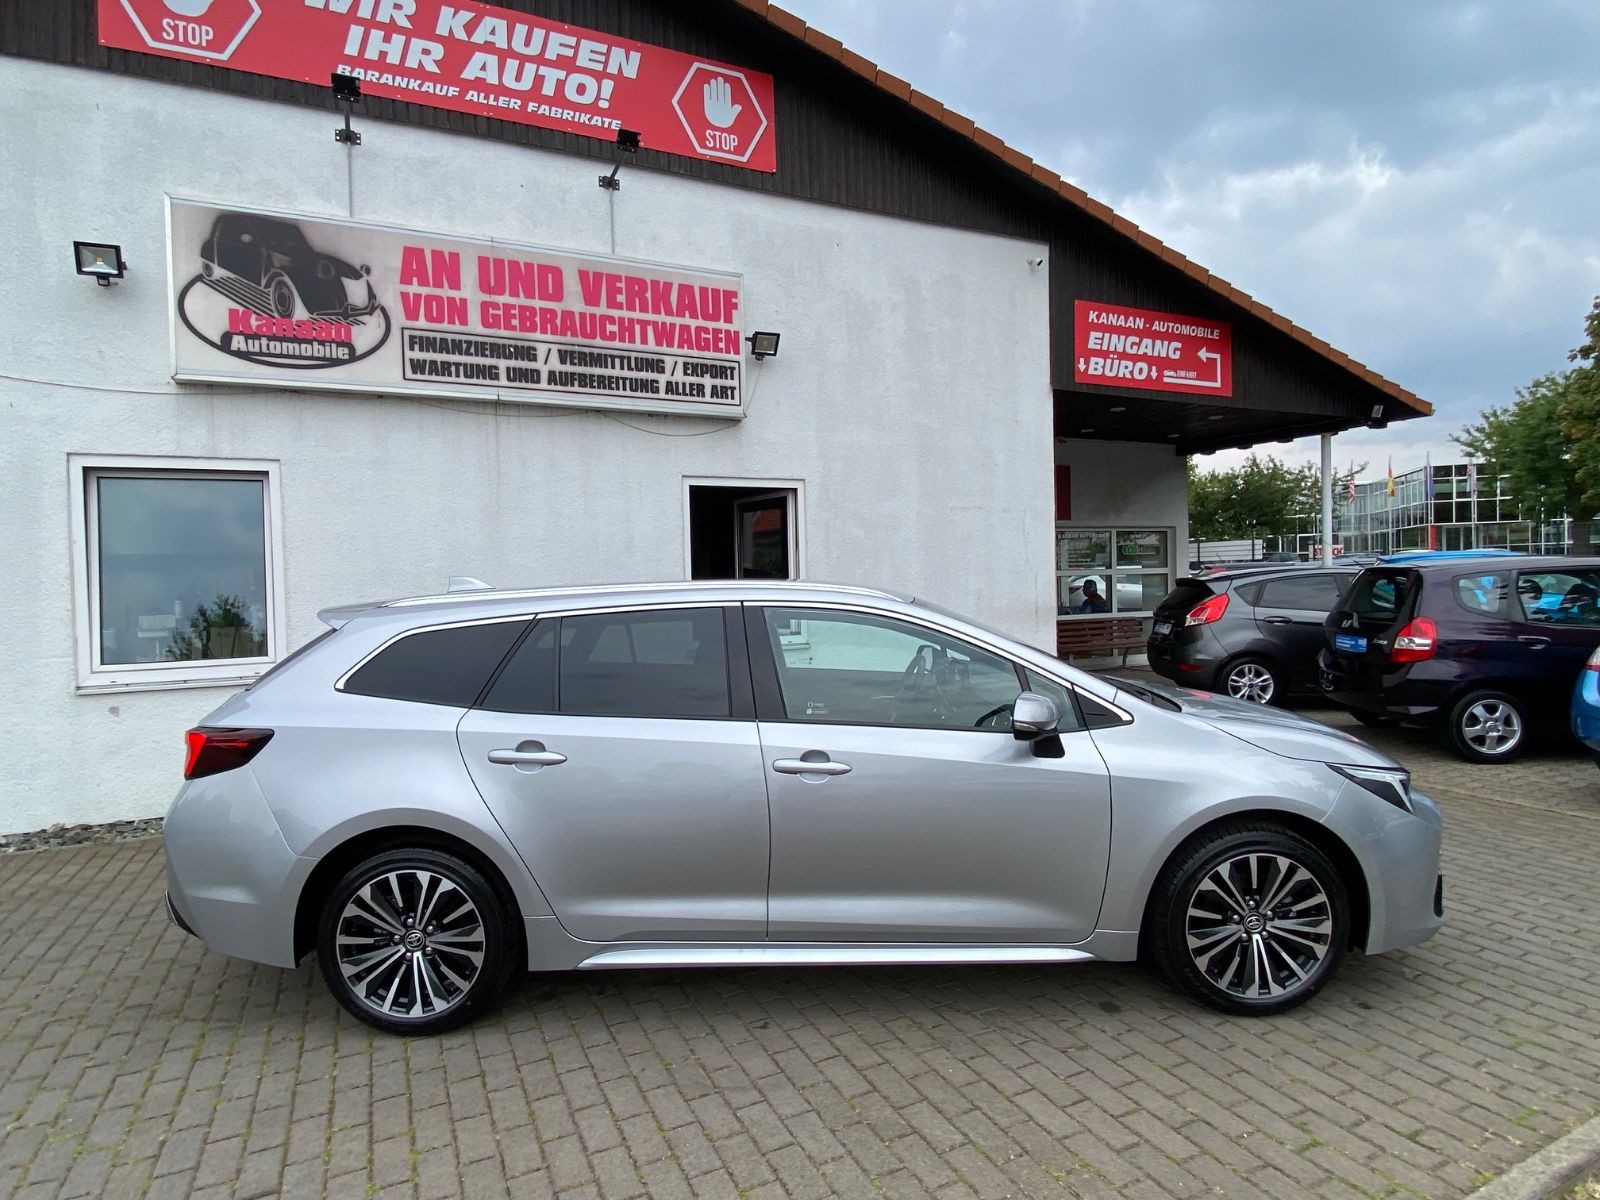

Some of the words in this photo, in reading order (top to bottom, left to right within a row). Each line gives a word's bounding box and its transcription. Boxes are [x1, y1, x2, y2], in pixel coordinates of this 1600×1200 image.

[162, 18, 214, 47] STOP
[435, 5, 641, 79] KAUFEN
[343, 24, 445, 74] IHR
[460, 51, 614, 109] AUTO!
[336, 64, 460, 97] BARANKAUF
[465, 90, 521, 111] ALLER
[527, 102, 622, 130] FABRIKATE
[705, 129, 739, 152] STOP
[400, 246, 461, 290] AN
[477, 255, 564, 303] UND
[578, 269, 739, 324] VERKAUF
[227, 308, 352, 343] Kanaan
[400, 291, 468, 326] VON
[480, 301, 740, 355] GEBRAUCHTWAGEN
[1088, 310, 1144, 330] KANAAN
[1152, 320, 1220, 340] AUTOMOBILE
[231, 334, 350, 360] Automobile
[408, 334, 537, 363] FINANZIERUNG
[558, 348, 666, 375] VERMITTLUNG
[683, 361, 736, 381] EXPORT
[1088, 331, 1182, 360] EINGANG
[409, 358, 500, 381] WARTUNG
[506, 366, 541, 385] UND
[547, 370, 659, 394] AUFBEREITUNG
[665, 381, 706, 398] ALLER
[710, 385, 736, 400] ART
[1088, 354, 1149, 380] BÜRO
